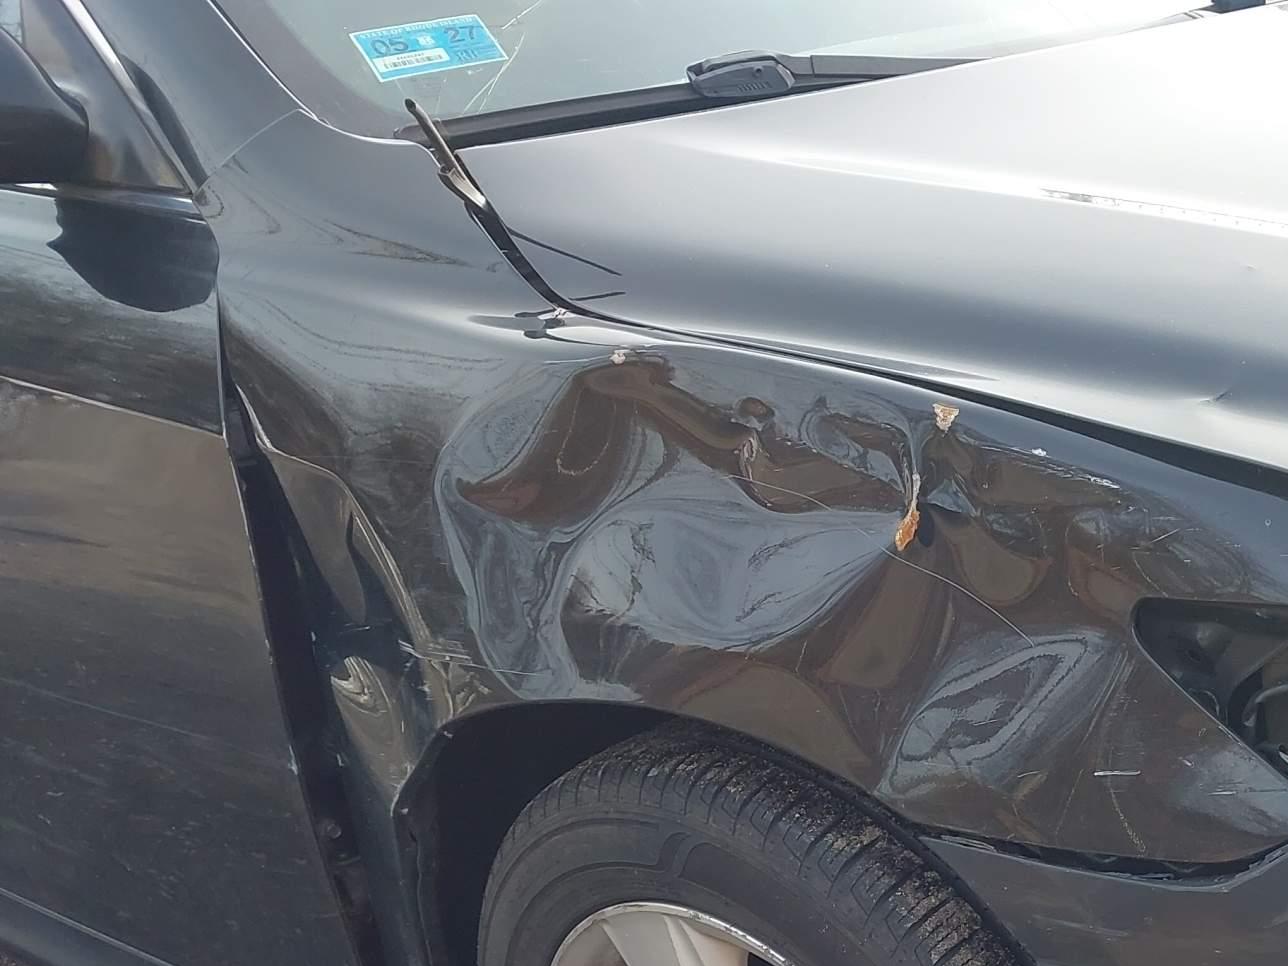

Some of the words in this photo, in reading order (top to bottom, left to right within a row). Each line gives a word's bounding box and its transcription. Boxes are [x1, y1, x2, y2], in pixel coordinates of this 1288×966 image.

[359, 30, 389, 39] STATE
[390, 27, 403, 35] OF
[404, 22, 437, 32] RHODE
[439, 17, 474, 27] ISLAND
[370, 36, 409, 55] 05
[444, 26, 476, 43] 27
